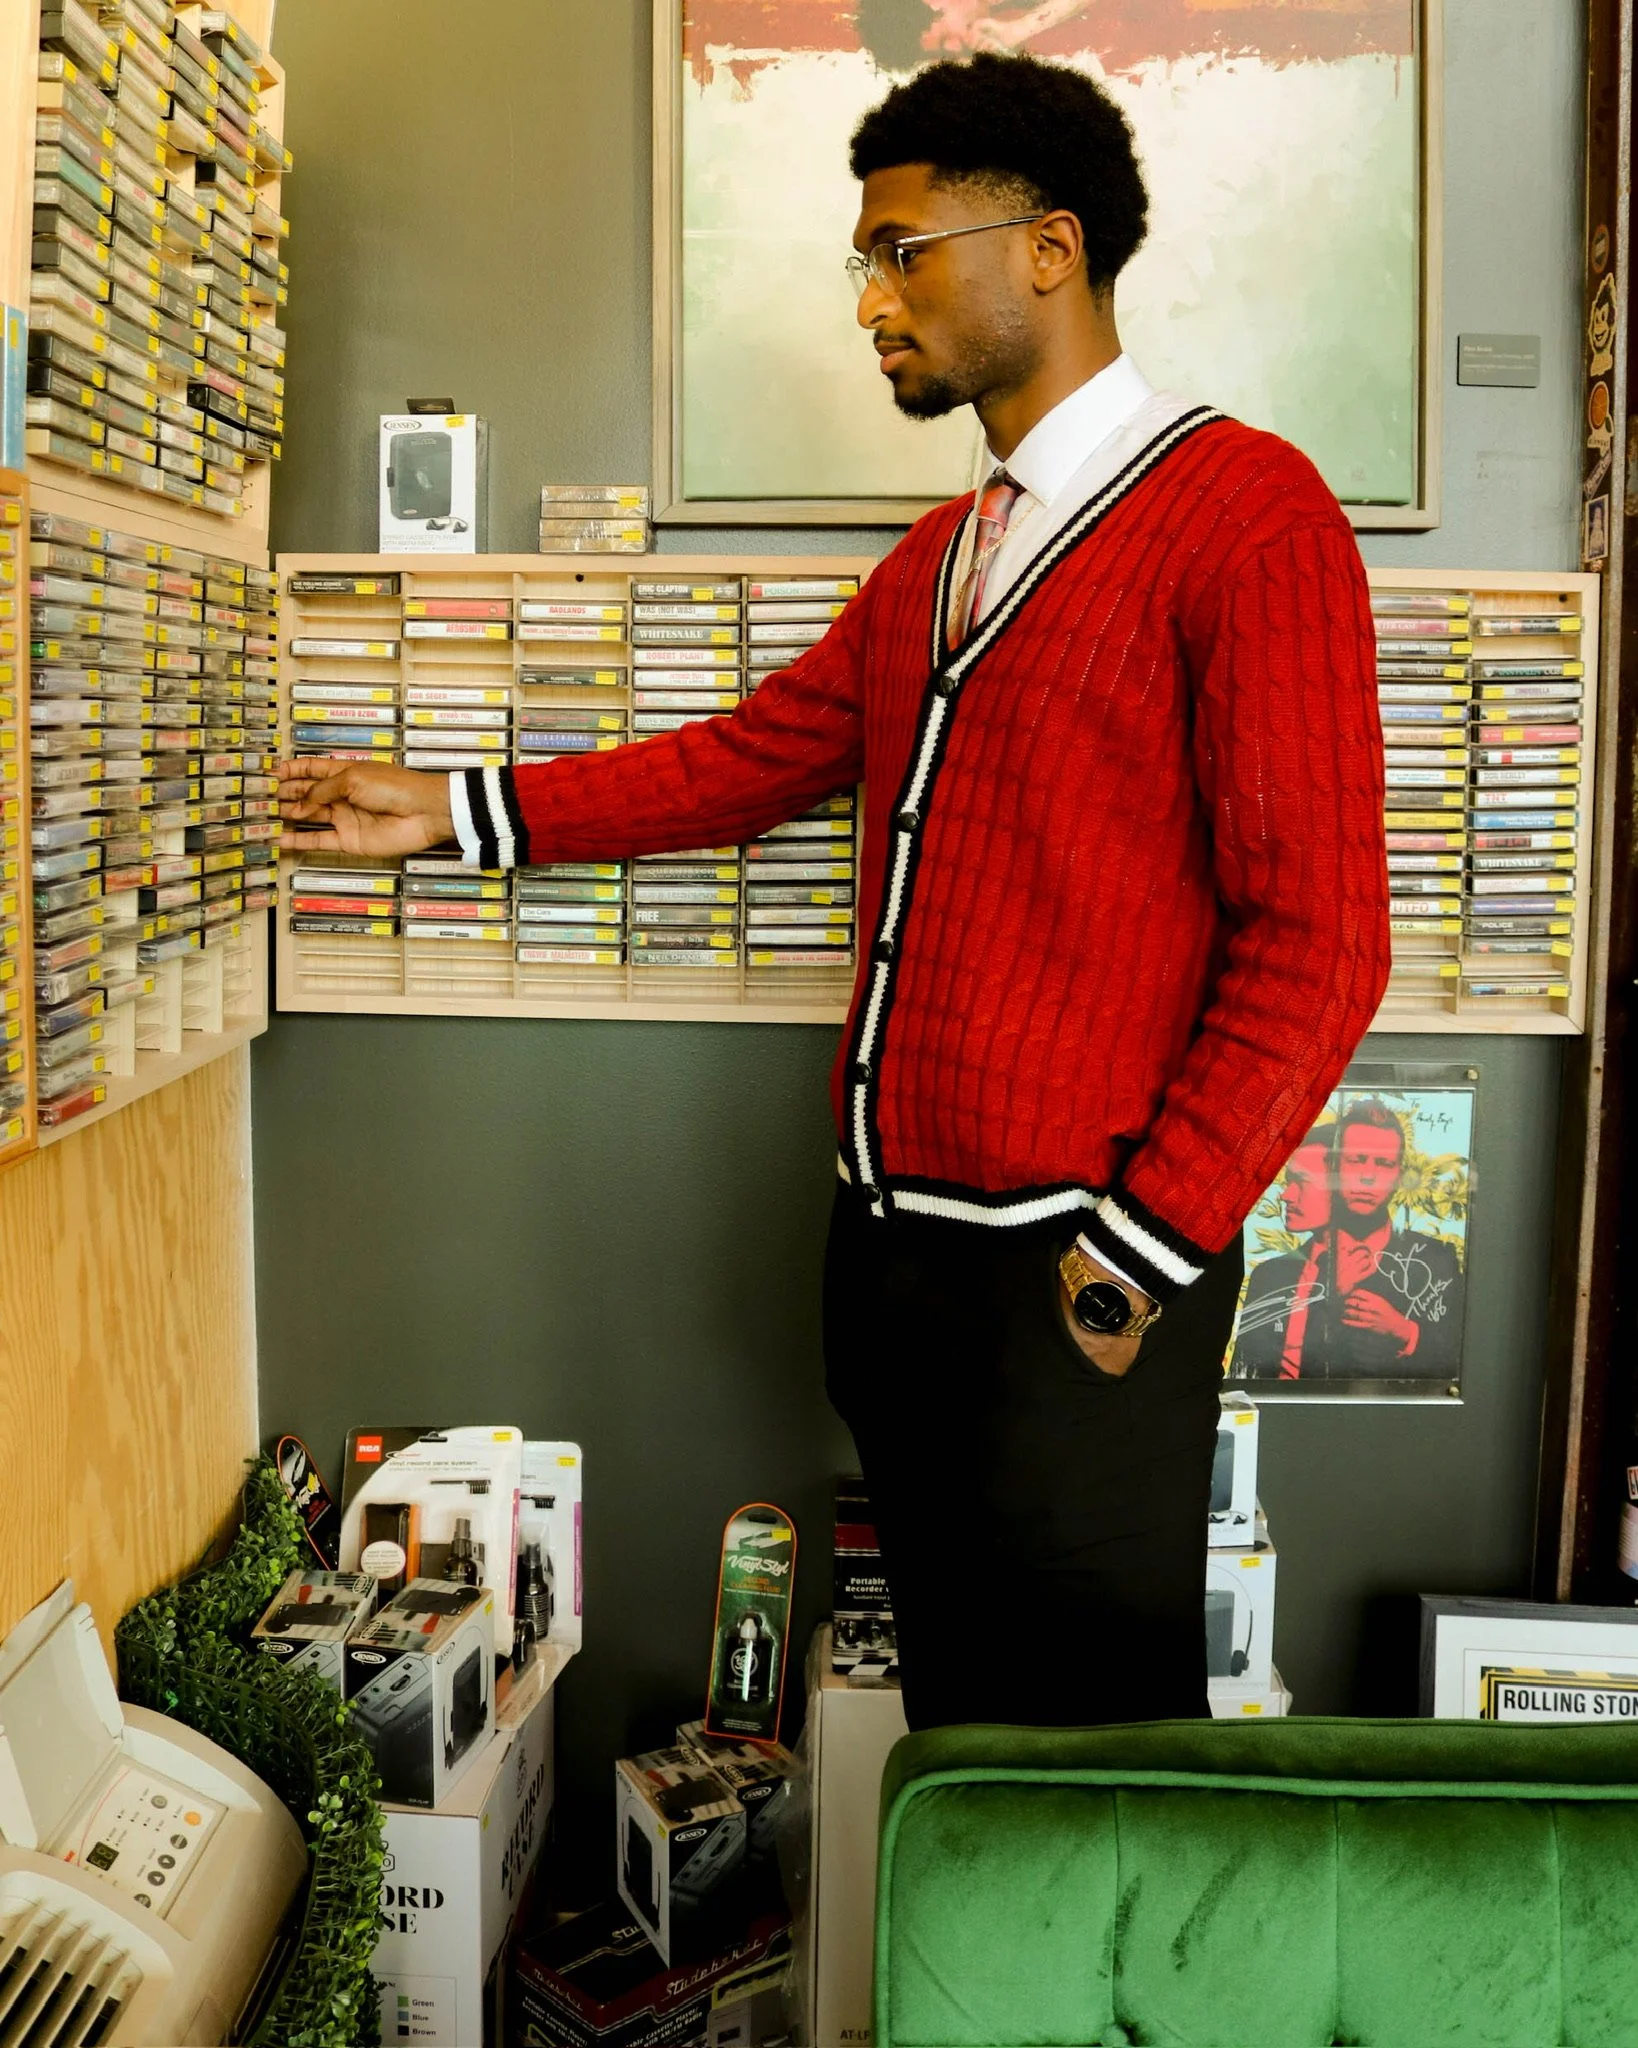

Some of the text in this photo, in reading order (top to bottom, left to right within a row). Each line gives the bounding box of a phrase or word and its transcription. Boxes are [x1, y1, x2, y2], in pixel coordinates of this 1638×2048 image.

[638, 584, 688, 593] ERIC CLAPTON
[640, 606, 654, 614] WAS
[446, 623, 487, 634] AEROSMITH
[640, 630, 704, 639] WHITESNAKE
[645, 652, 704, 660] ROBERT PLANT
[1416, 666, 1441, 675] VAULT
[1515, 687, 1550, 695] CINDERELLA
[1479, 858, 1542, 867] WHITESNAKE
[1393, 902, 1429, 913] UTFO
[636, 911, 659, 922] FREE
[648, 953, 670, 961] NEIL
[359, 1444, 381, 1453] RCA
[451, 1461, 478, 1469] system
[727, 1554, 763, 1574] Vinyl
[850, 1577, 886, 1586] Portable
[1504, 1689, 1586, 1713] ROLLING
[379, 1885, 444, 1908] ORD
[379, 1912, 417, 1934] SE
[412, 1999, 435, 2008] Green
[683, 2011, 703, 2026] Radio
[412, 2028, 437, 2036] Brown
[645, 2020, 674, 2042] Cassette
